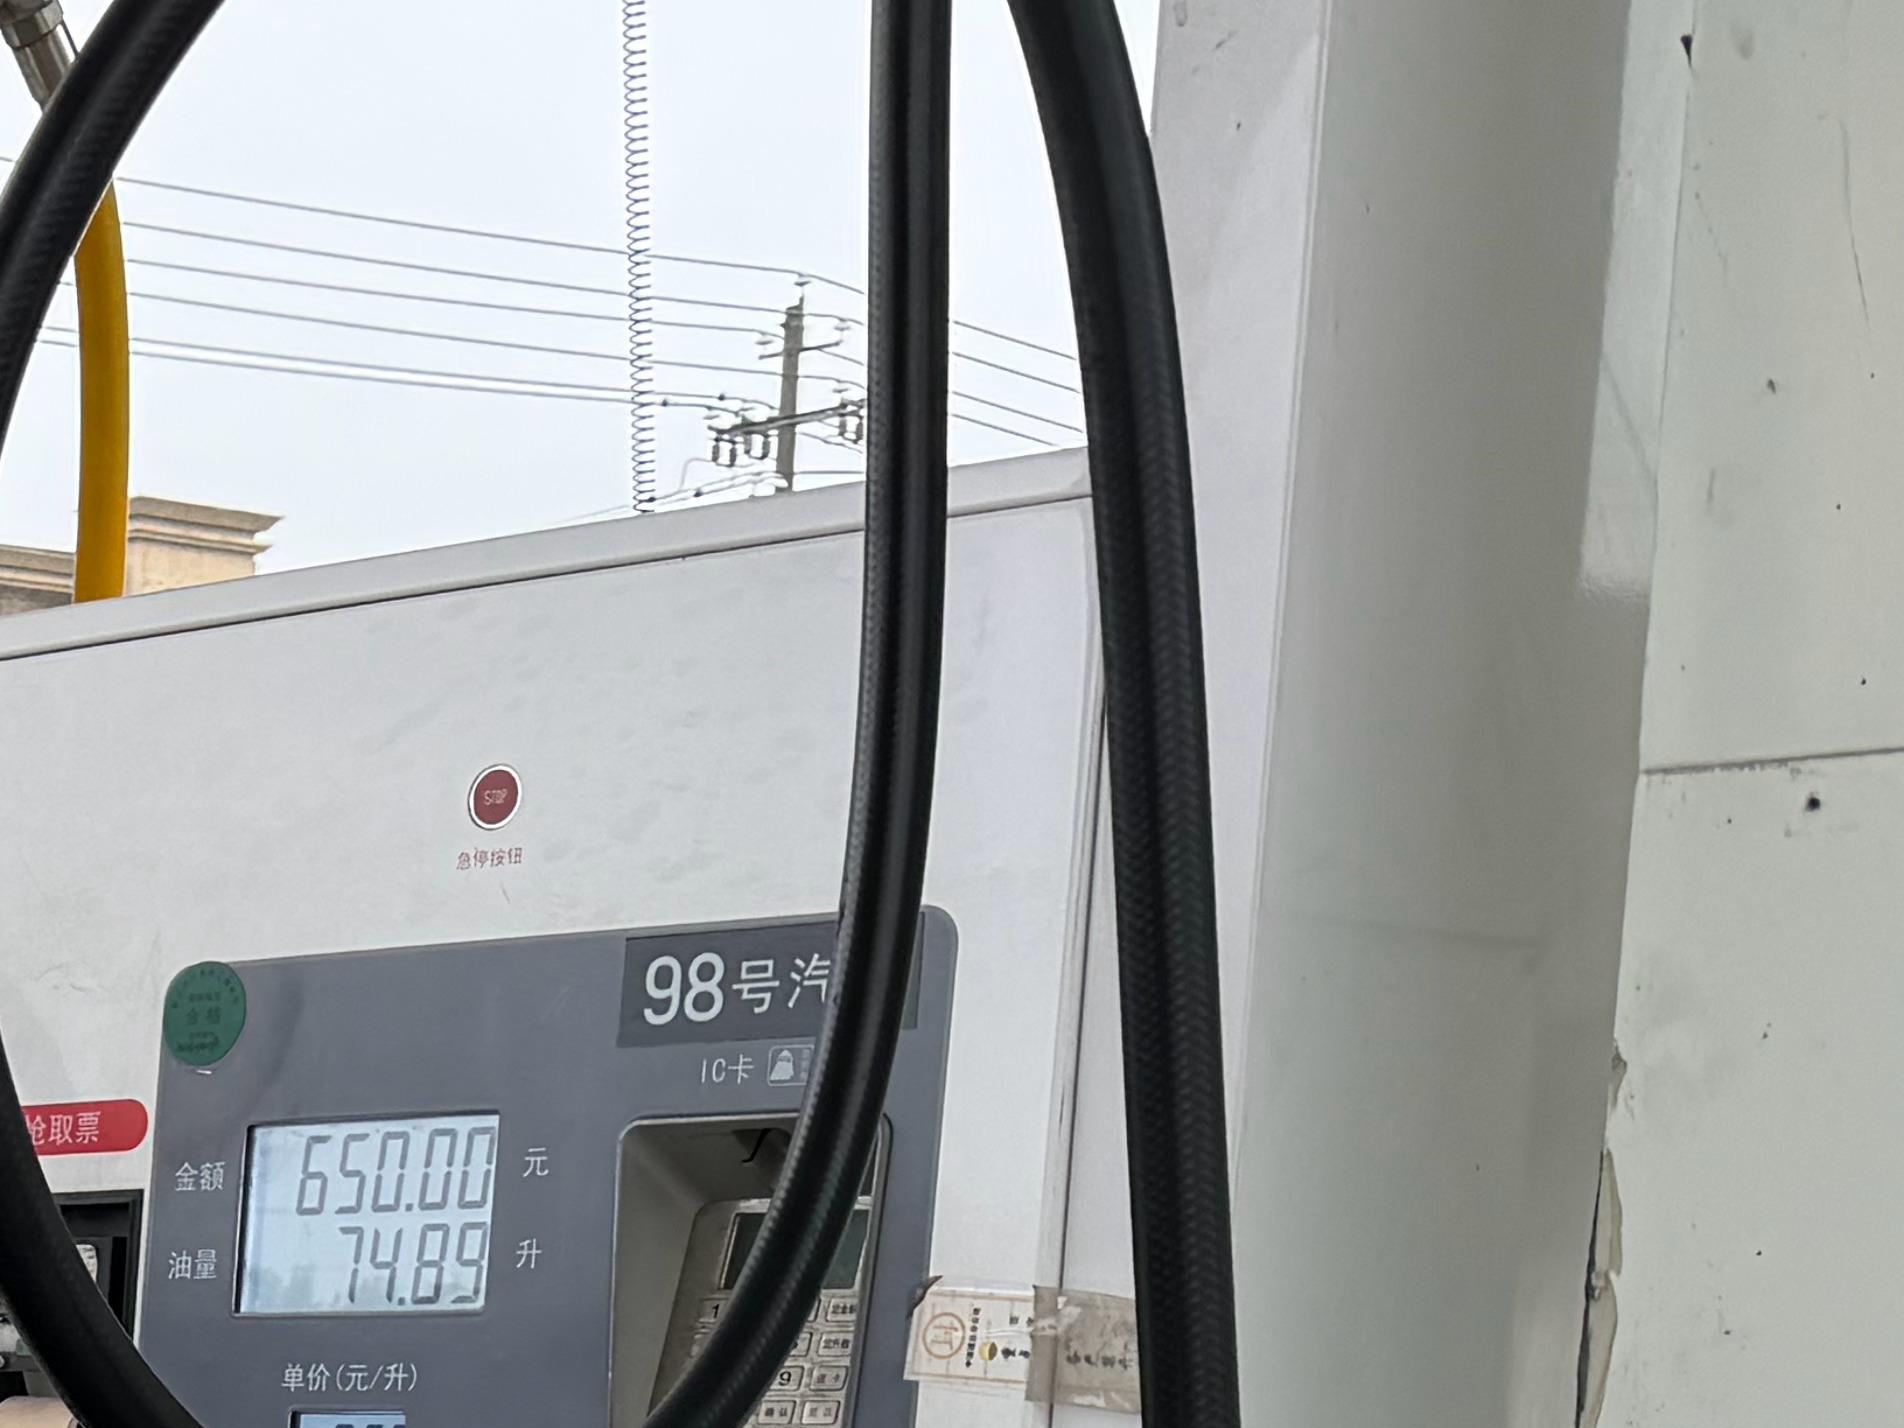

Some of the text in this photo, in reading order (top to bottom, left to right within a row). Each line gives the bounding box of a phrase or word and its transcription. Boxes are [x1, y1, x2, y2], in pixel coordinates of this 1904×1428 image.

[456, 847, 522, 871] 急停按钮
[644, 952, 831, 1025] 98号汽
[701, 1054, 754, 1084] IC卡
[175, 1162, 225, 1191] 金额
[296, 1126, 496, 1215] 650.00
[523, 1148, 549, 1179] 元
[168, 1249, 217, 1280] 油量
[339, 1222, 487, 1305] 74.89
[516, 1238, 542, 1269] 升
[712, 1304, 720, 1318] 1
[281, 1363, 417, 1392] 单价(元/升)
[778, 1371, 792, 1387] 9
